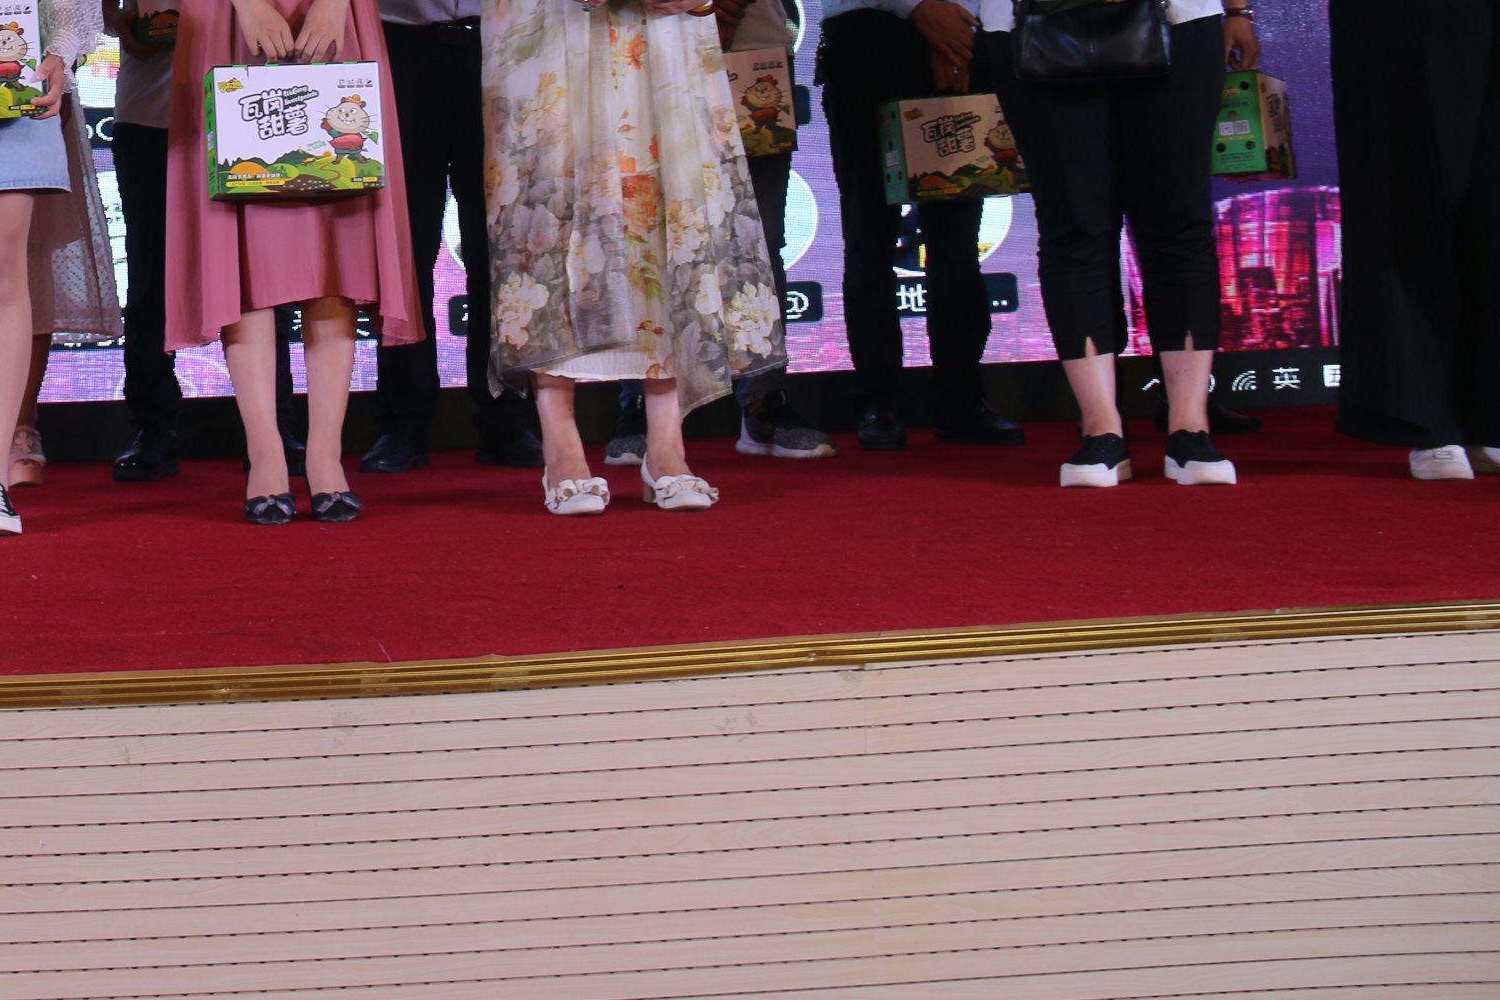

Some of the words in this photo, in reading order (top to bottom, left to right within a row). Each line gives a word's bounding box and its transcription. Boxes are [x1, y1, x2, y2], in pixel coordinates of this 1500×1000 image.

[238, 89, 284, 121] 瓦岗
[257, 103, 308, 140] 甜薯
[1272, 367, 1301, 389] 英
